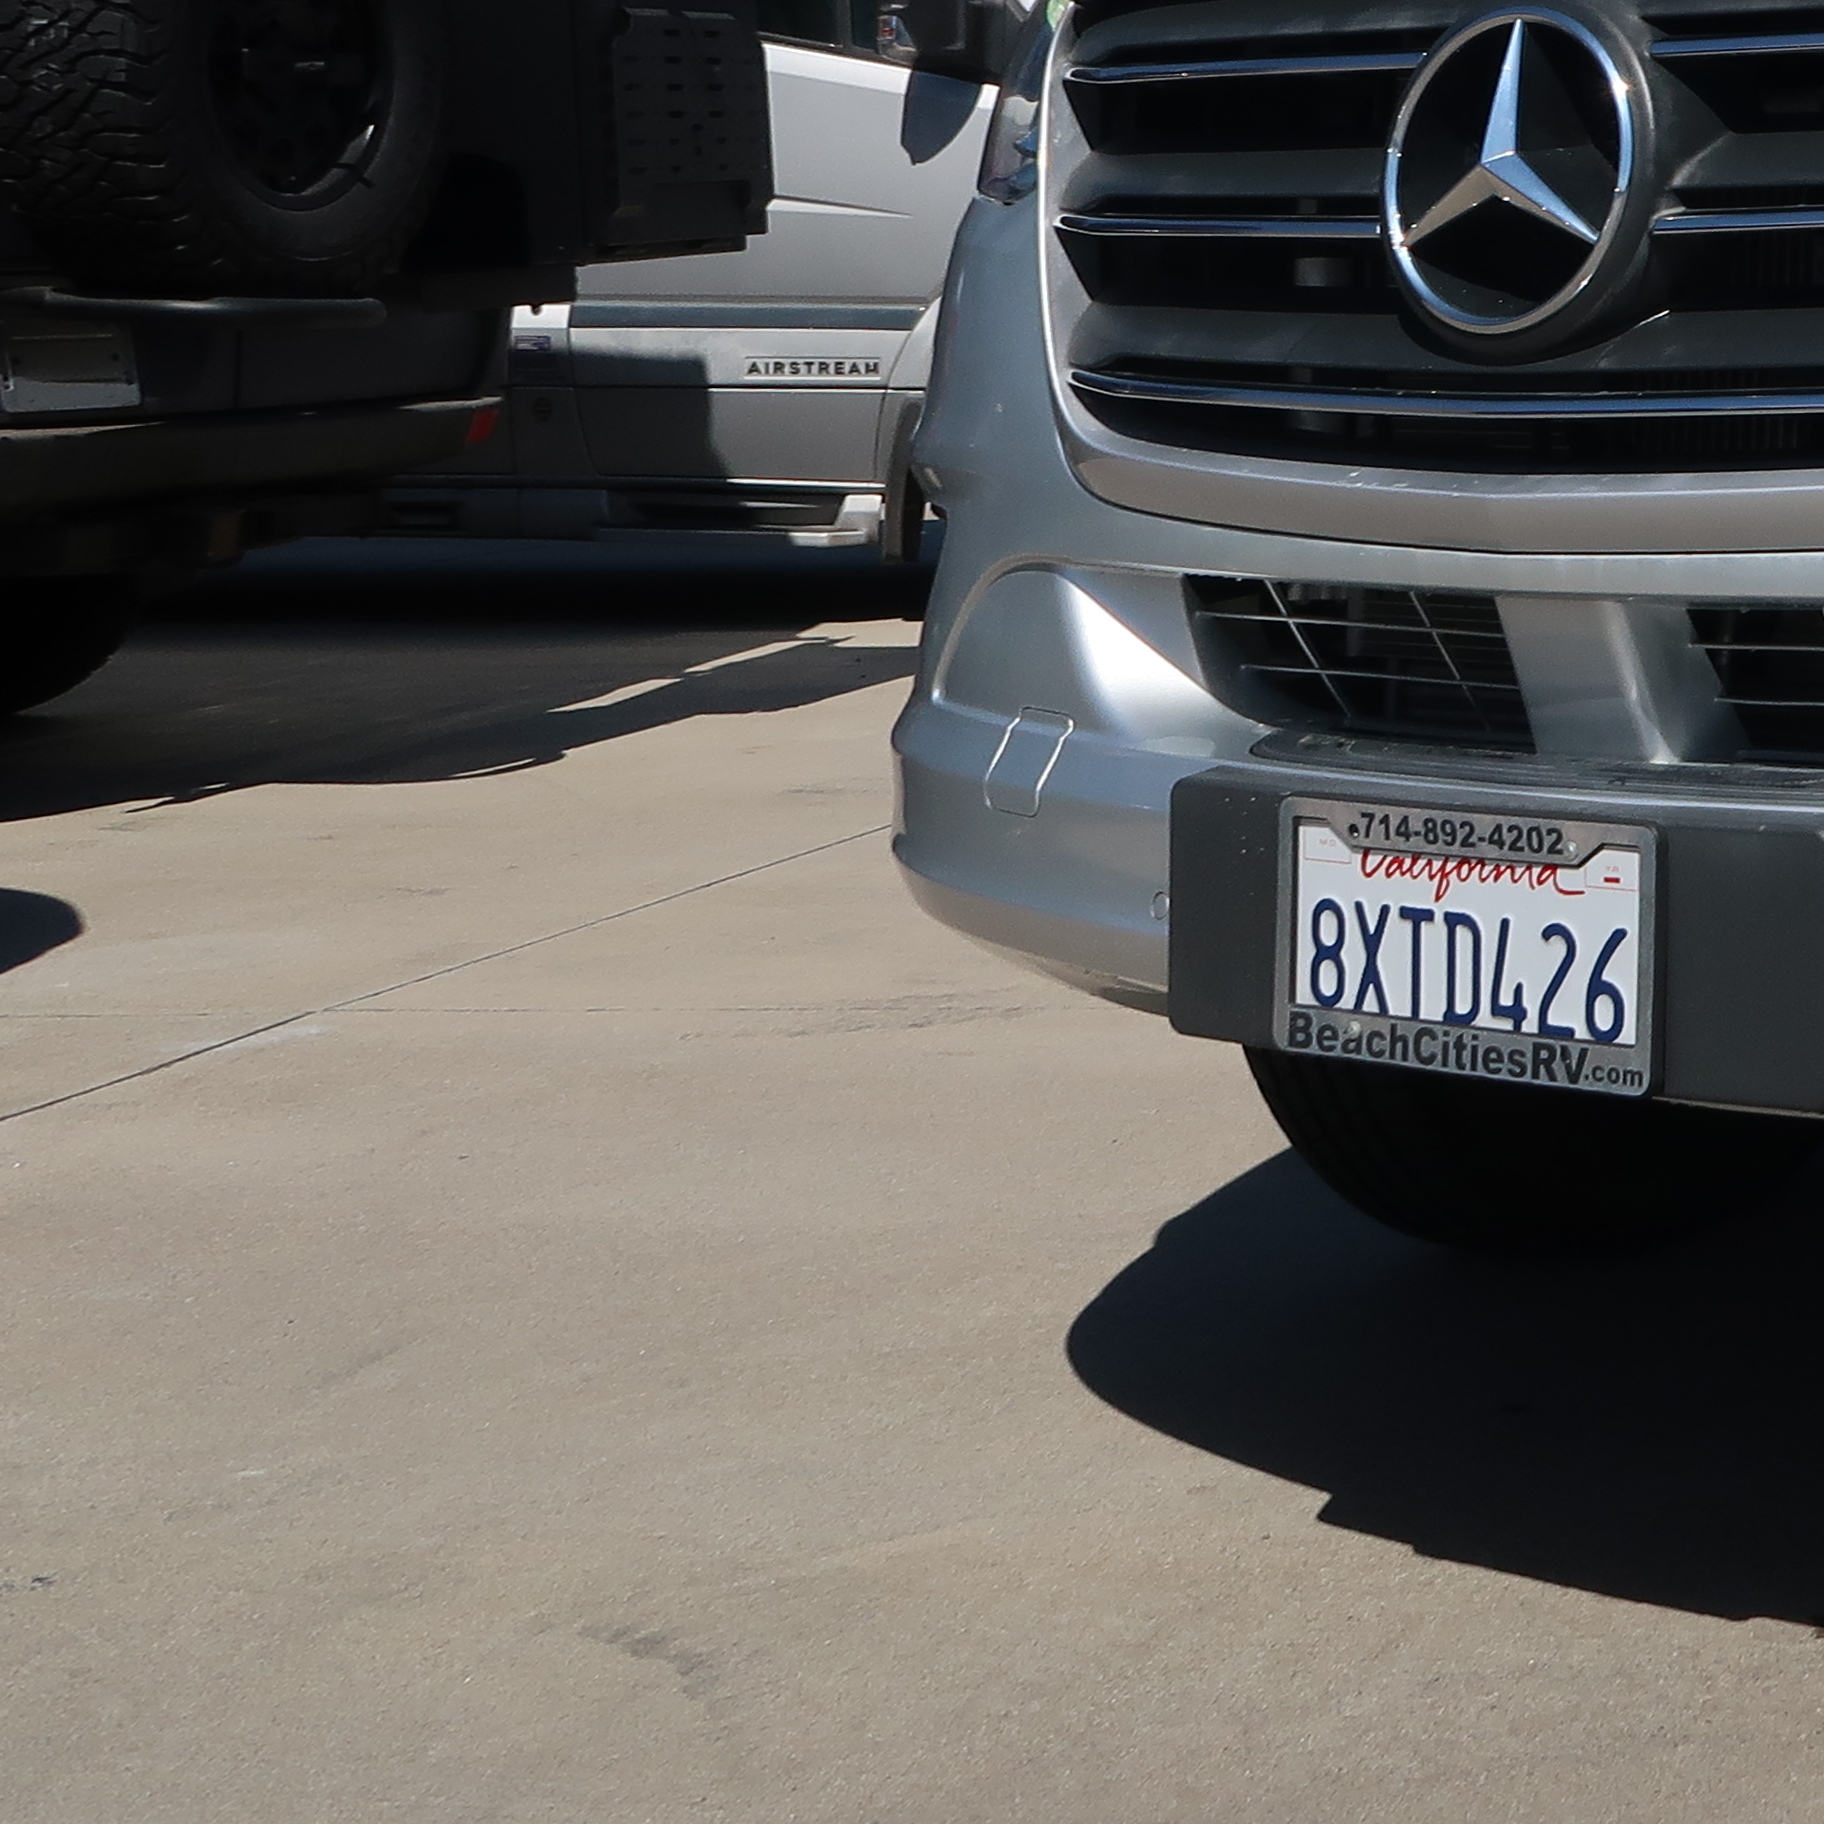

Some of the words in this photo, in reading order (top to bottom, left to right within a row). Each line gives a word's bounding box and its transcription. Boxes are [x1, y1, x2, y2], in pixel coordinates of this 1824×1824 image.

[746, 360, 880, 376] AIRSTREAM
[1359, 812, 1564, 856] 714-892-4202
[1310, 898, 1628, 1044] 8XTD426
[1288, 1013, 1644, 1085] BeachCitiesRV.com
